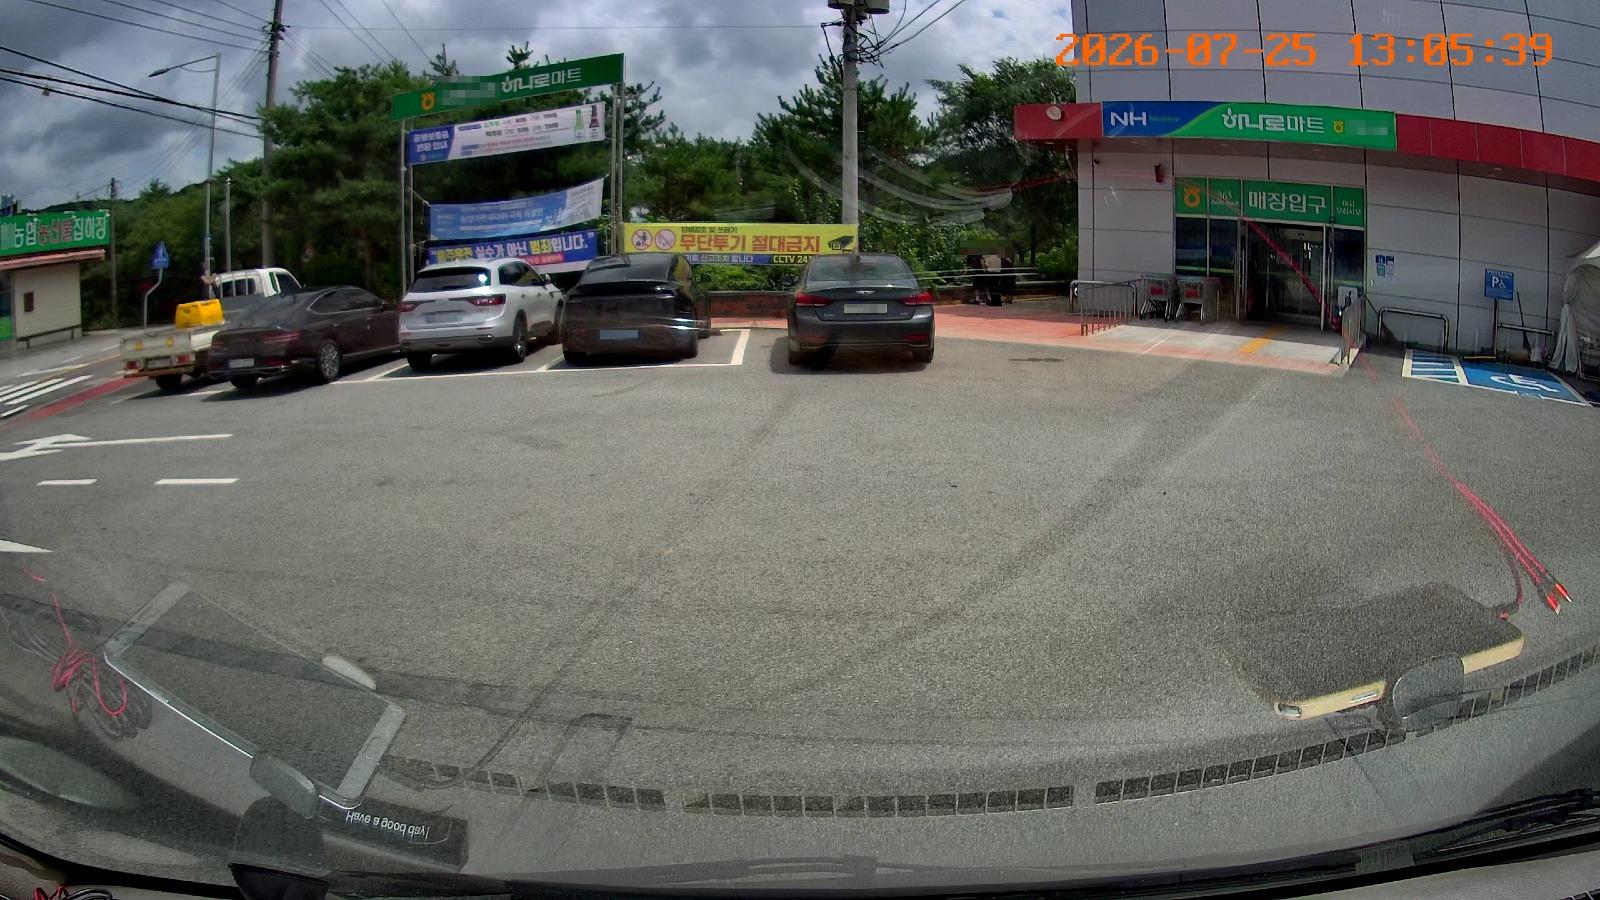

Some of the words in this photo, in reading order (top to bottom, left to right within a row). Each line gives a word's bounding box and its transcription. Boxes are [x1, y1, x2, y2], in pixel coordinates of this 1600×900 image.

[502, 68, 582, 93] 하나로마트
[1110, 111, 1148, 127] NH
[1221, 108, 1325, 134] 하나로마트
[433, 140, 449, 151] 안내
[1248, 191, 1327, 215] 매장입구
[475, 244, 504, 259] 실수가
[506, 240, 529, 256] 아닌
[680, 234, 746, 251] 무단투기
[752, 235, 820, 252] 절대금지
[731, 254, 753, 263] 합니다
[773, 255, 795, 263] CCTV
[1491, 275, 1500, 288] P
